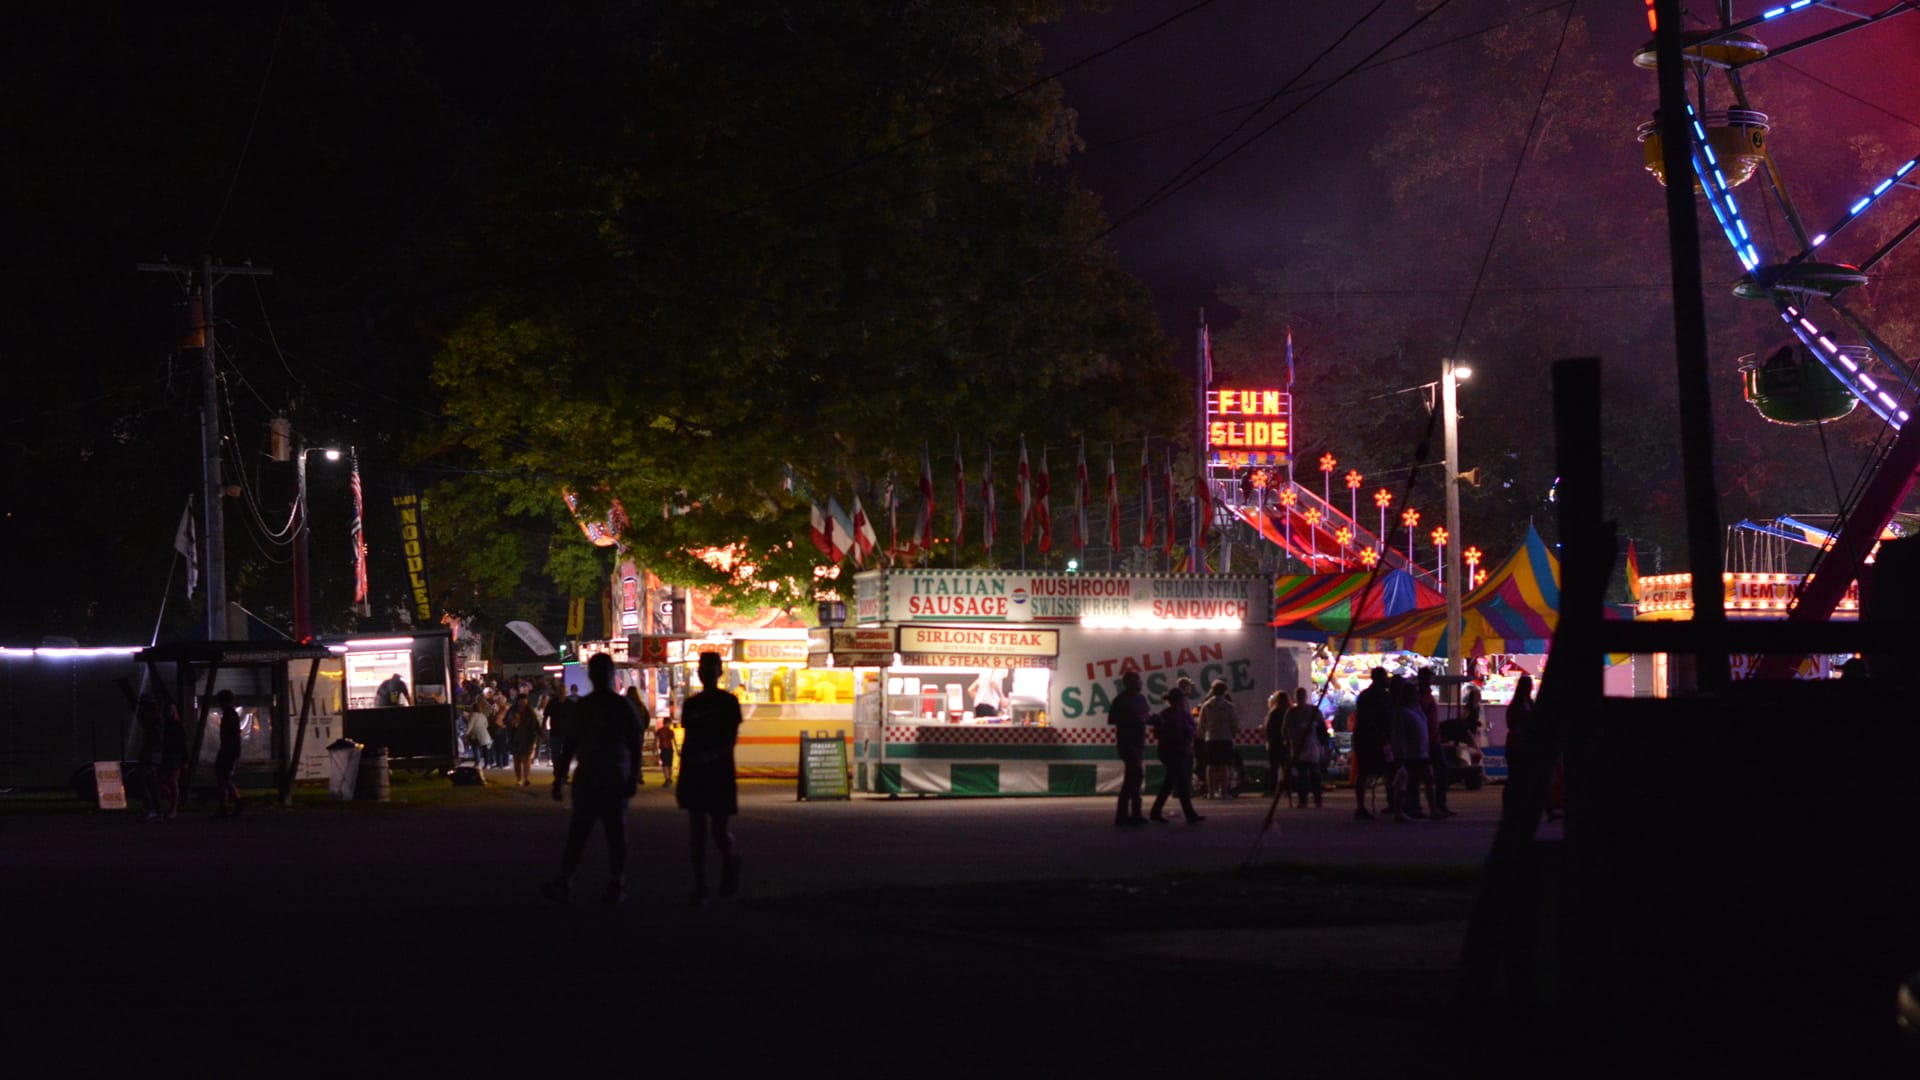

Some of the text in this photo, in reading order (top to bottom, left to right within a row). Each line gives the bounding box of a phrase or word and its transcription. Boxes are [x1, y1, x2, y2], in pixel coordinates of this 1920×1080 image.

[1219, 390, 1279, 415] FUN
[1210, 421, 1287, 446] SLIDE
[401, 508, 431, 620] NOODLES
[912, 577, 1006, 595] ITALIAN
[1031, 579, 1130, 596] MUSHROOM
[1153, 580, 1249, 599] SIRLOIN STEAK
[909, 596, 1008, 616] SAUSAGE
[1031, 597, 1130, 616] SWISSBURGER
[1153, 600, 1249, 618] SANDWICH
[917, 630, 1041, 646] SIRLOIN STEAK
[903, 655, 946, 667] PHILLY
[949, 655, 991, 667] STEAK
[994, 656, 1001, 667] &
[1005, 656, 1054, 668] CHEESE
[1086, 642, 1224, 681] ITALIAN
